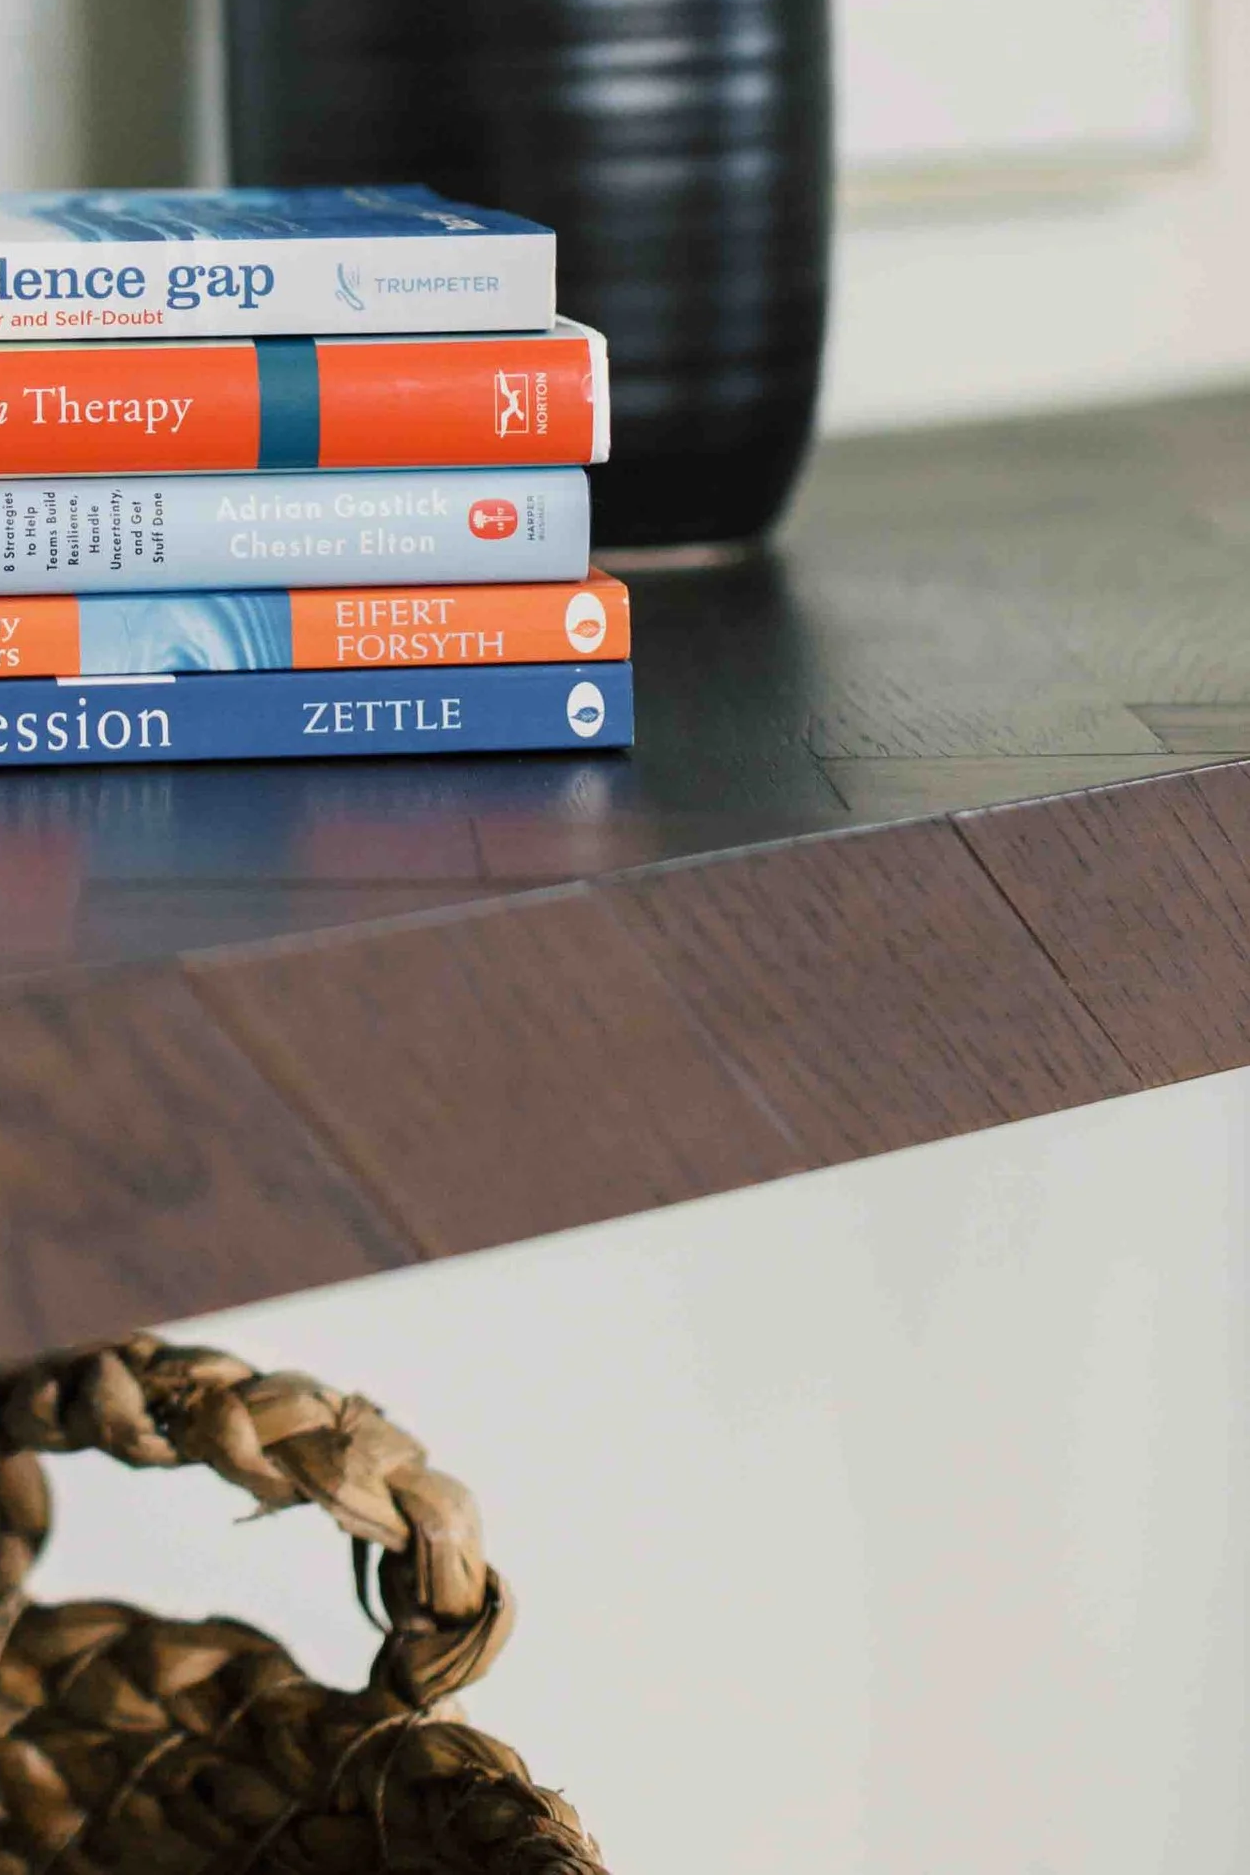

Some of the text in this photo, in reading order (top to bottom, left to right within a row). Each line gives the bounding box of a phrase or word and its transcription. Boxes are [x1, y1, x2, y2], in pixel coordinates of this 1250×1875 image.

[166, 262, 275, 310] gap
[375, 276, 499, 294] TRUMPETER
[11, 311, 47, 327] and
[56, 309, 163, 326] Self-Doubt
[23, 386, 194, 434] Therapy
[536, 372, 548, 435] NORTON
[87, 505, 100, 554] Handle
[110, 489, 123, 570] Uncertainty,
[131, 501, 143, 556] and Get
[152, 492, 164, 563] Stuff Done
[216, 489, 449, 522] Adrian Gostick
[526, 495, 536, 541] HARPER
[2, 492, 17, 572] 8 Strategies
[24, 506, 38, 556] to Help
[43, 492, 58, 571] Teams Build
[66, 495, 80, 566] Resilience,
[230, 530, 435, 559] Chester Elton
[336, 598, 455, 628] EIFERT
[337, 632, 504, 661] FORSYTH
[302, 699, 461, 733] ZETTLE
